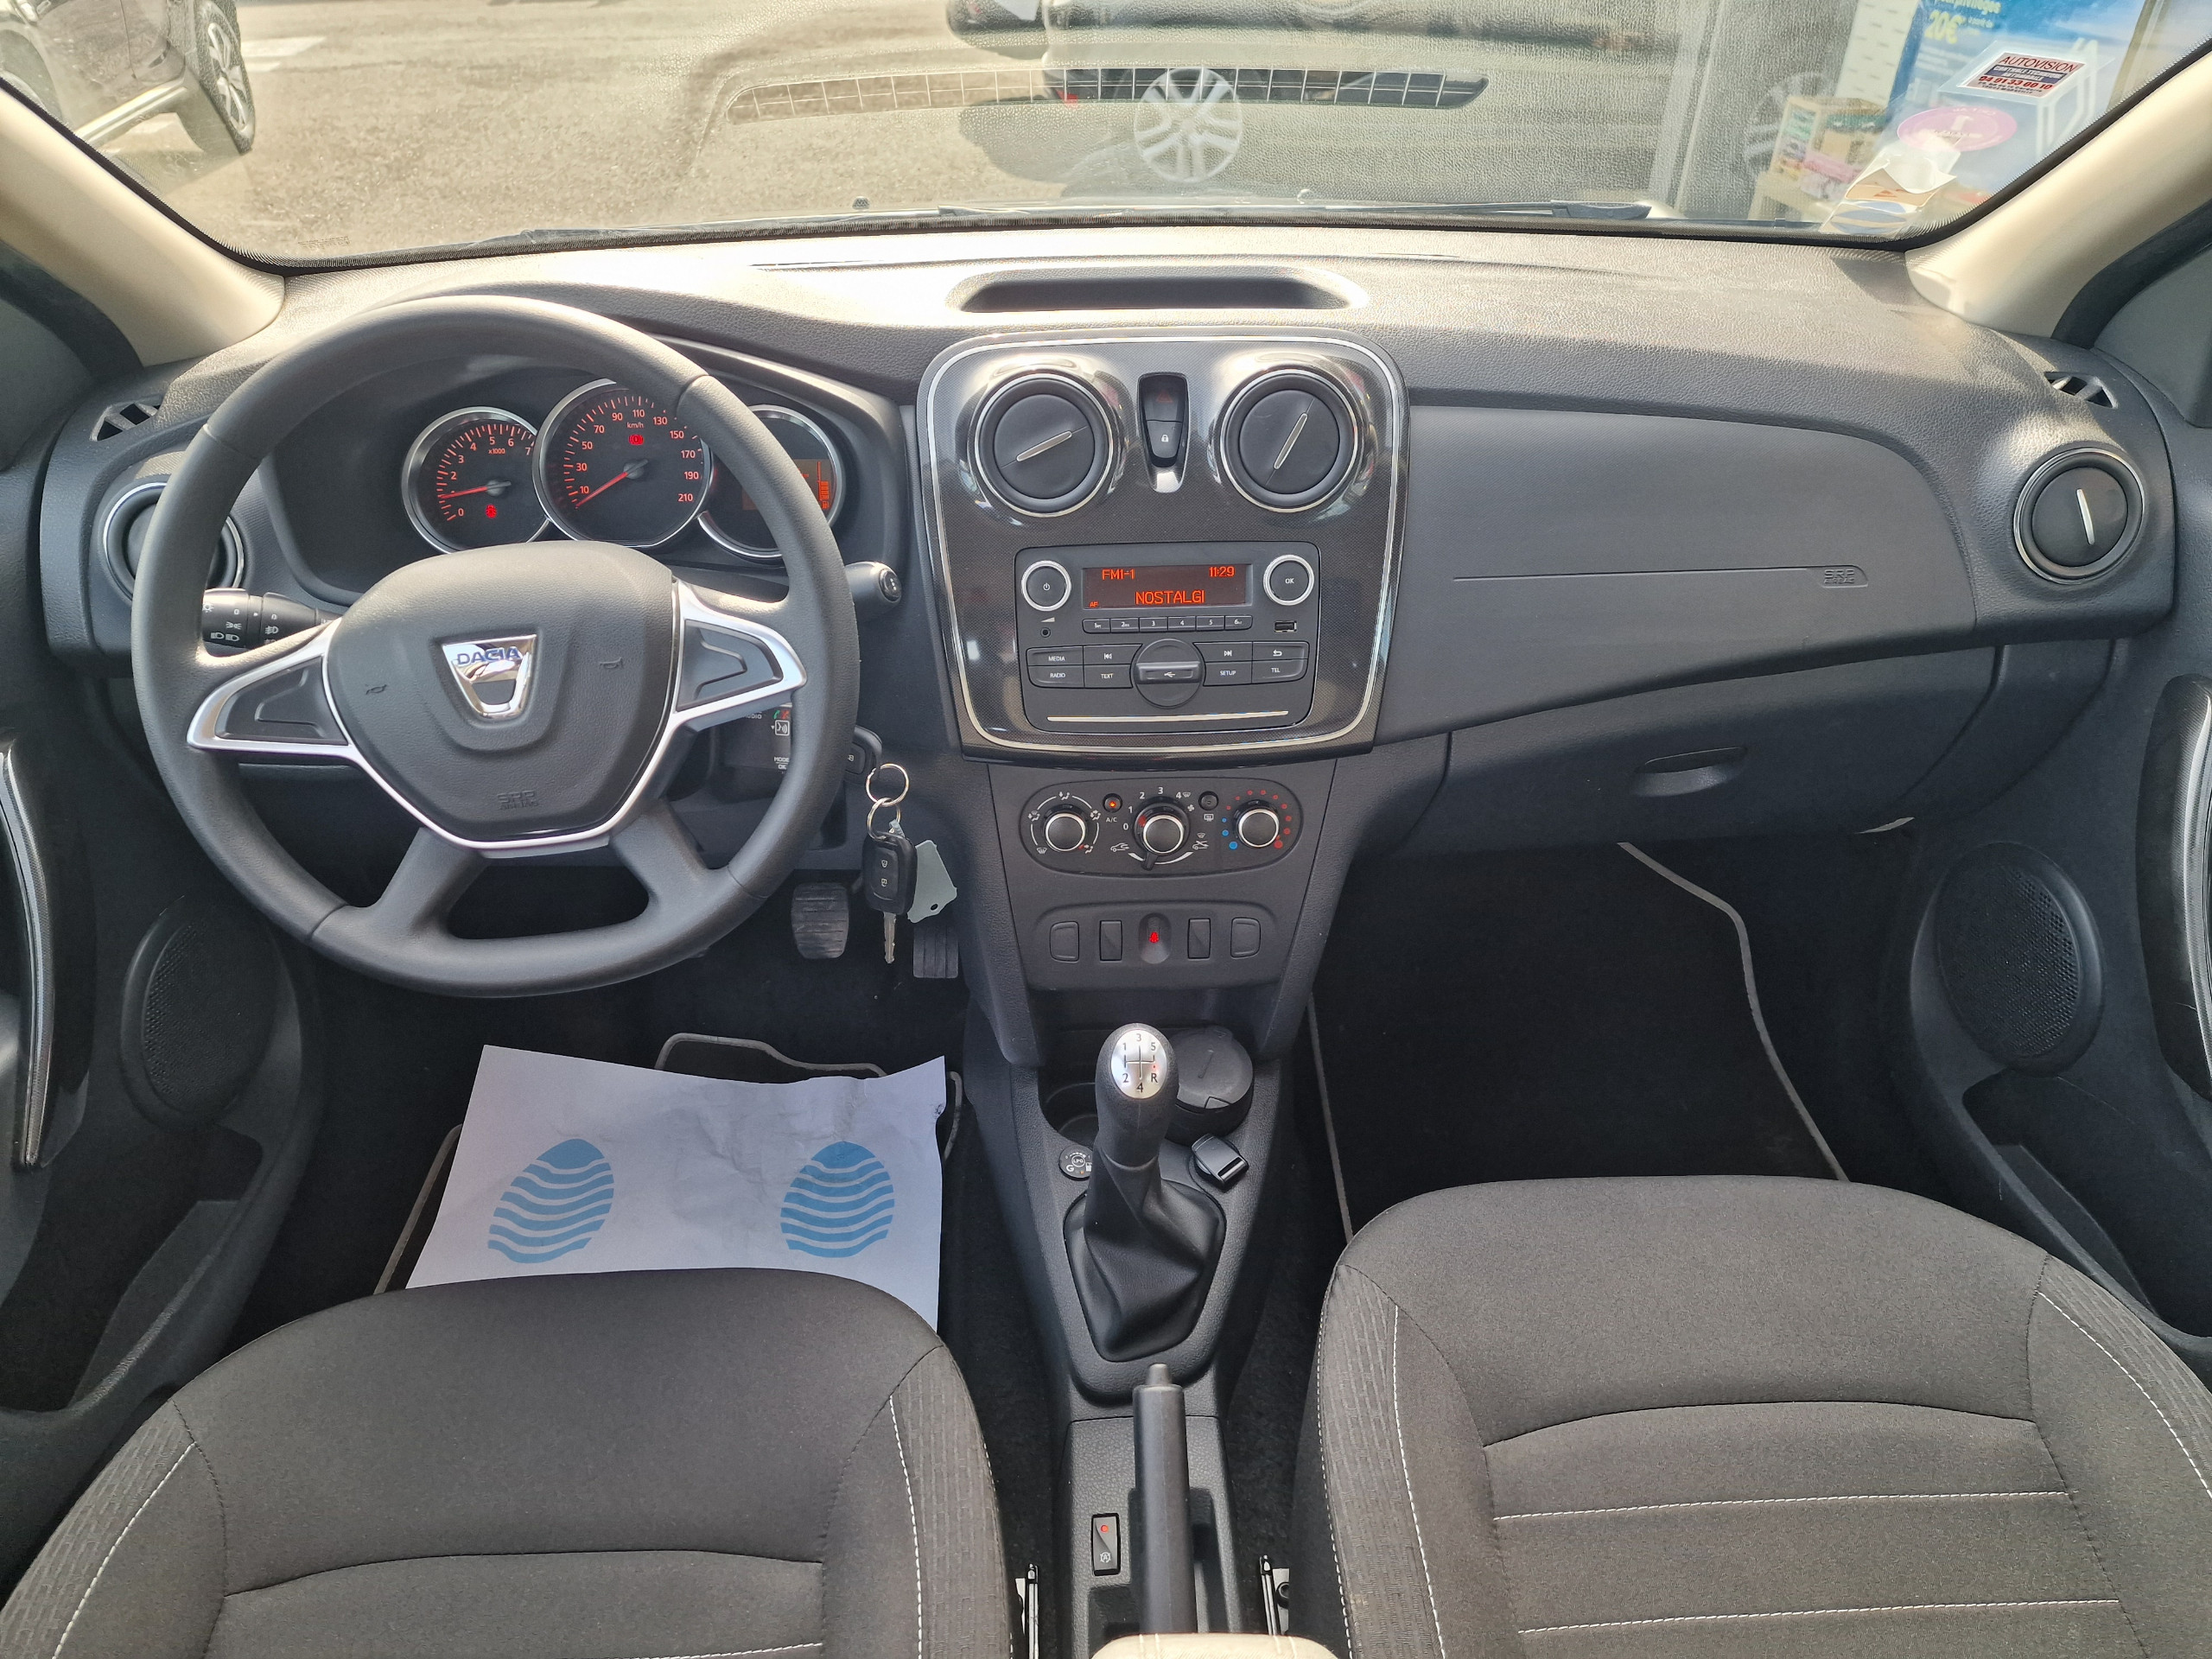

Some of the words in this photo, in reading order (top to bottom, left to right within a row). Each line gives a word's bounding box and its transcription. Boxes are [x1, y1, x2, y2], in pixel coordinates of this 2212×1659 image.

[1999, 56, 2078, 72] AUTOVISION
[653, 416, 667, 425] 130
[670, 430, 683, 439] 150
[489, 436, 495, 445] 5
[508, 438, 514, 447] 6
[470, 442, 476, 451] 4
[681, 450, 696, 459] 170
[684, 471, 699, 480] 190
[580, 486, 589, 494] 10
[678, 493, 693, 502] 210
[458, 508, 464, 517] 0
[1102, 569, 1135, 580] FM1-1
[1209, 566, 1235, 577] 11:29
[1135, 590, 1205, 604] NOSTALGI
[457, 646, 523, 665] DACIA
[1136, 1033, 1141, 1042] 3
[1151, 1042, 1156, 1051] 5
[1122, 1073, 1129, 1083] 2
[1151, 1073, 1158, 1083] R
[1136, 1082, 1143, 1092] 4
